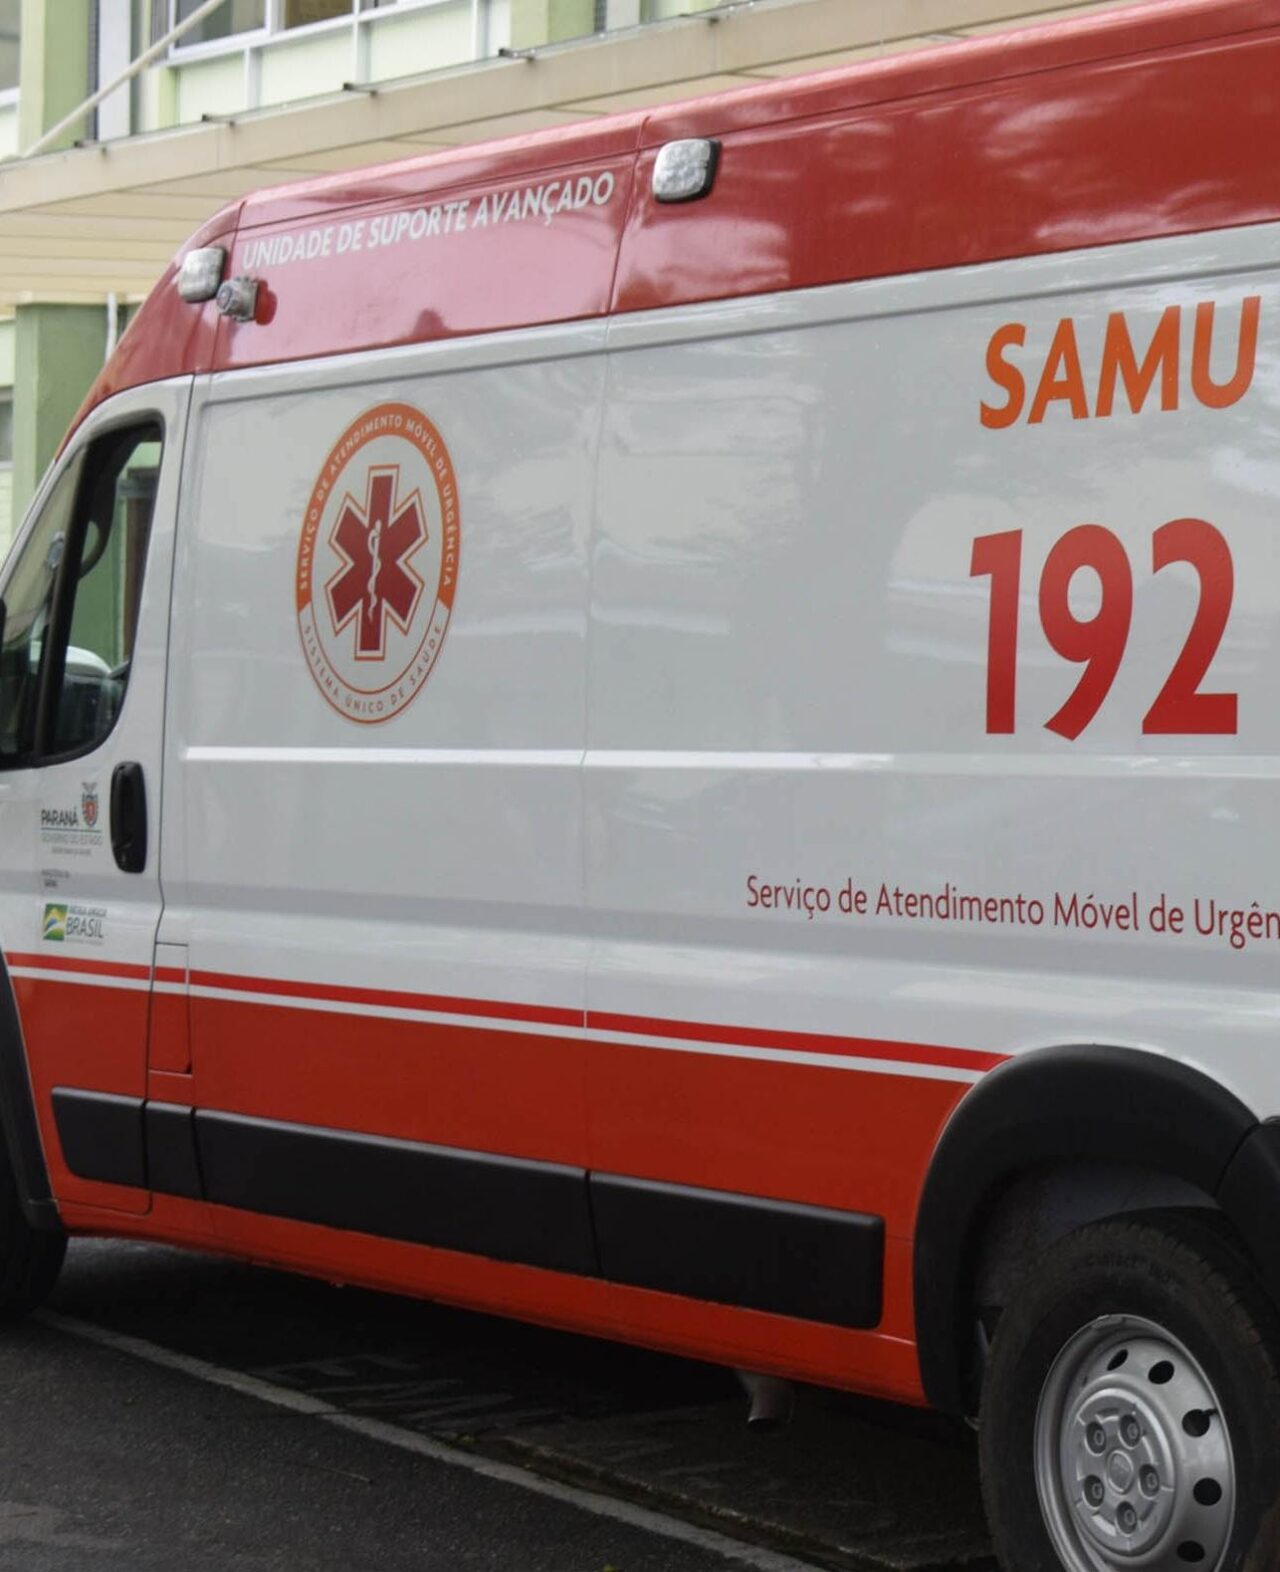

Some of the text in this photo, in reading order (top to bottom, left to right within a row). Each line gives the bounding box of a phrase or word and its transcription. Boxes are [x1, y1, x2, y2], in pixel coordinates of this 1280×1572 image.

[242, 172, 615, 269] UNIDADE DE SUPORTE AVANÇADO
[980, 295, 1261, 430] SAMU
[300, 413, 458, 590] SERVIÇO DE ATENDIMENTO MÓVEL DE URGÊNCIA
[969, 517, 1239, 742] 192
[390, 686, 406, 706] DE
[41, 807, 78, 826] PARANÁ
[66, 917, 104, 939] BRASIL
[746, 875, 833, 918] Serviço
[838, 878, 868, 914] de
[875, 882, 1045, 926] Atendimento
[1053, 892, 1140, 932] Móvel
[1149, 897, 1185, 934] de
